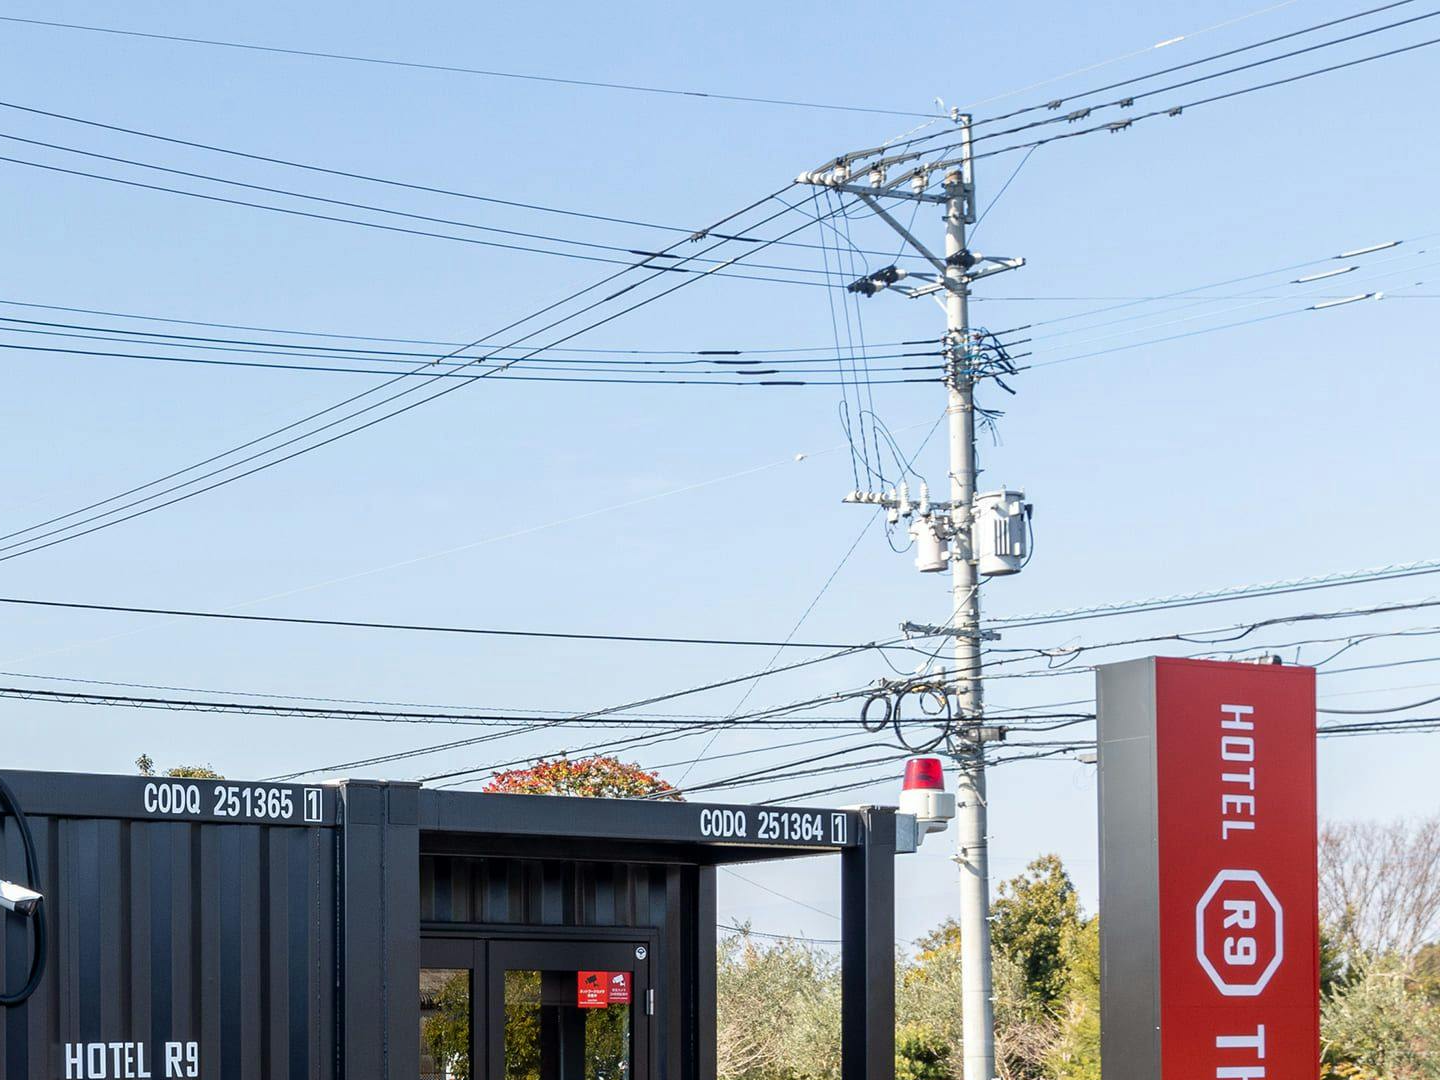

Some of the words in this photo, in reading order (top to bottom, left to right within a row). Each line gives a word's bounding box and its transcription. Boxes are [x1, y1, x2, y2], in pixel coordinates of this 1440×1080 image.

[1220, 704, 1255, 840] HOTEL
[144, 782, 201, 815] CODQ
[213, 785, 293, 819] 251365
[700, 808, 747, 838] CODQ
[757, 811, 823, 841] 251364
[1223, 900, 1257, 965] R9
[65, 1042, 152, 1080] HOTEL
[165, 1041, 199, 1078] R9
